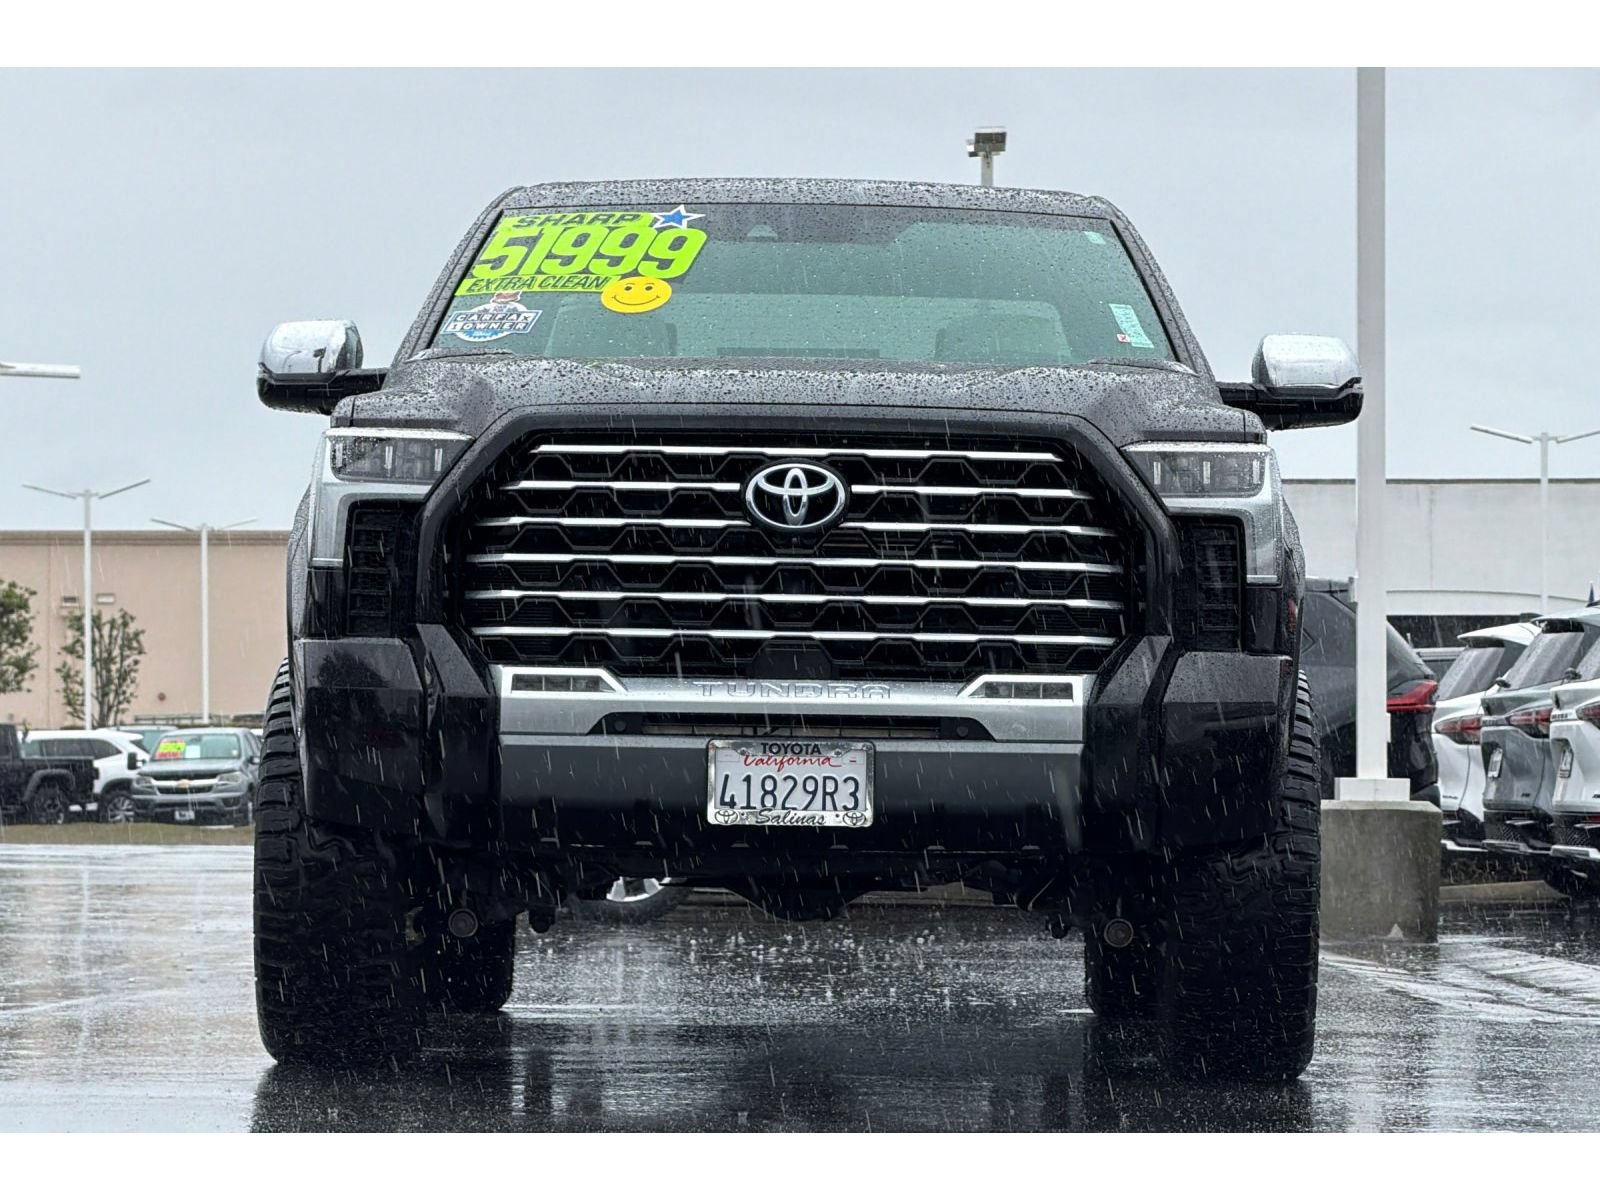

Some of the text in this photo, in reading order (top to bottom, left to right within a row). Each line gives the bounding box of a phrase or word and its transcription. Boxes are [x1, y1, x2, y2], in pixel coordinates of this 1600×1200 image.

[512, 213, 641, 228] SHARP
[472, 226, 707, 279] 51999
[467, 275, 611, 292] EXTRA CLEAN
[456, 313, 532, 321] CARFAX
[463, 322, 526, 330] OWNER
[693, 682, 891, 699] TUNDRA
[760, 742, 822, 755] TOYOTA
[743, 755, 842, 772] California
[719, 774, 860, 811] 41829R3
[755, 808, 827, 827] Salinas
